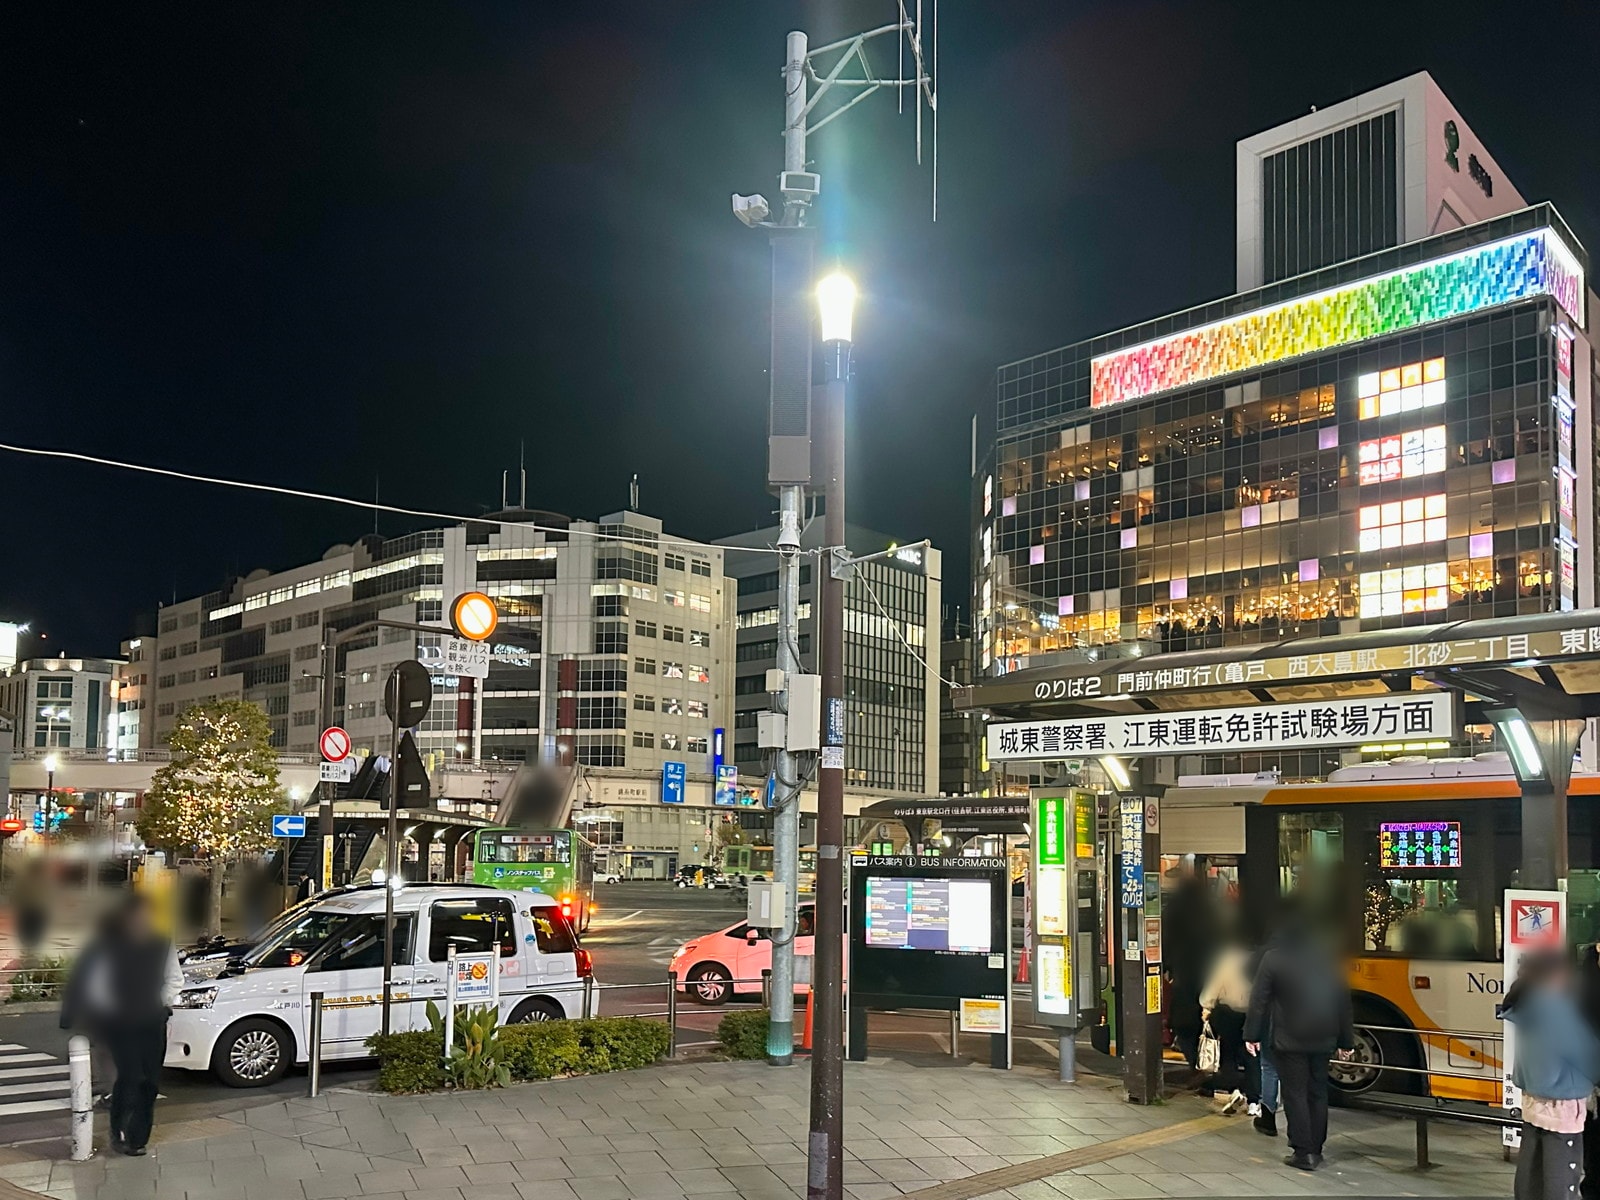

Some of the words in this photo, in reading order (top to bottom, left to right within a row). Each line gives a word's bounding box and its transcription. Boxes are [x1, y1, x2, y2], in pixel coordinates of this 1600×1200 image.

[449, 641, 488, 655] 路線バス
[448, 652, 487, 665] 観光バス
[448, 664, 471, 673] を除く
[1035, 677, 1101, 699] のりば2
[999, 700, 1434, 753] 城東警察署、江東運転免許試験場方面
[1121, 814, 1134, 879] 試験場まで
[869, 857, 902, 866] バス案内
[920, 858, 940, 867] BUS
[943, 858, 1006, 868] INFORMATION
[1122, 891, 1143, 906] のりば
[459, 963, 472, 972] 路上
